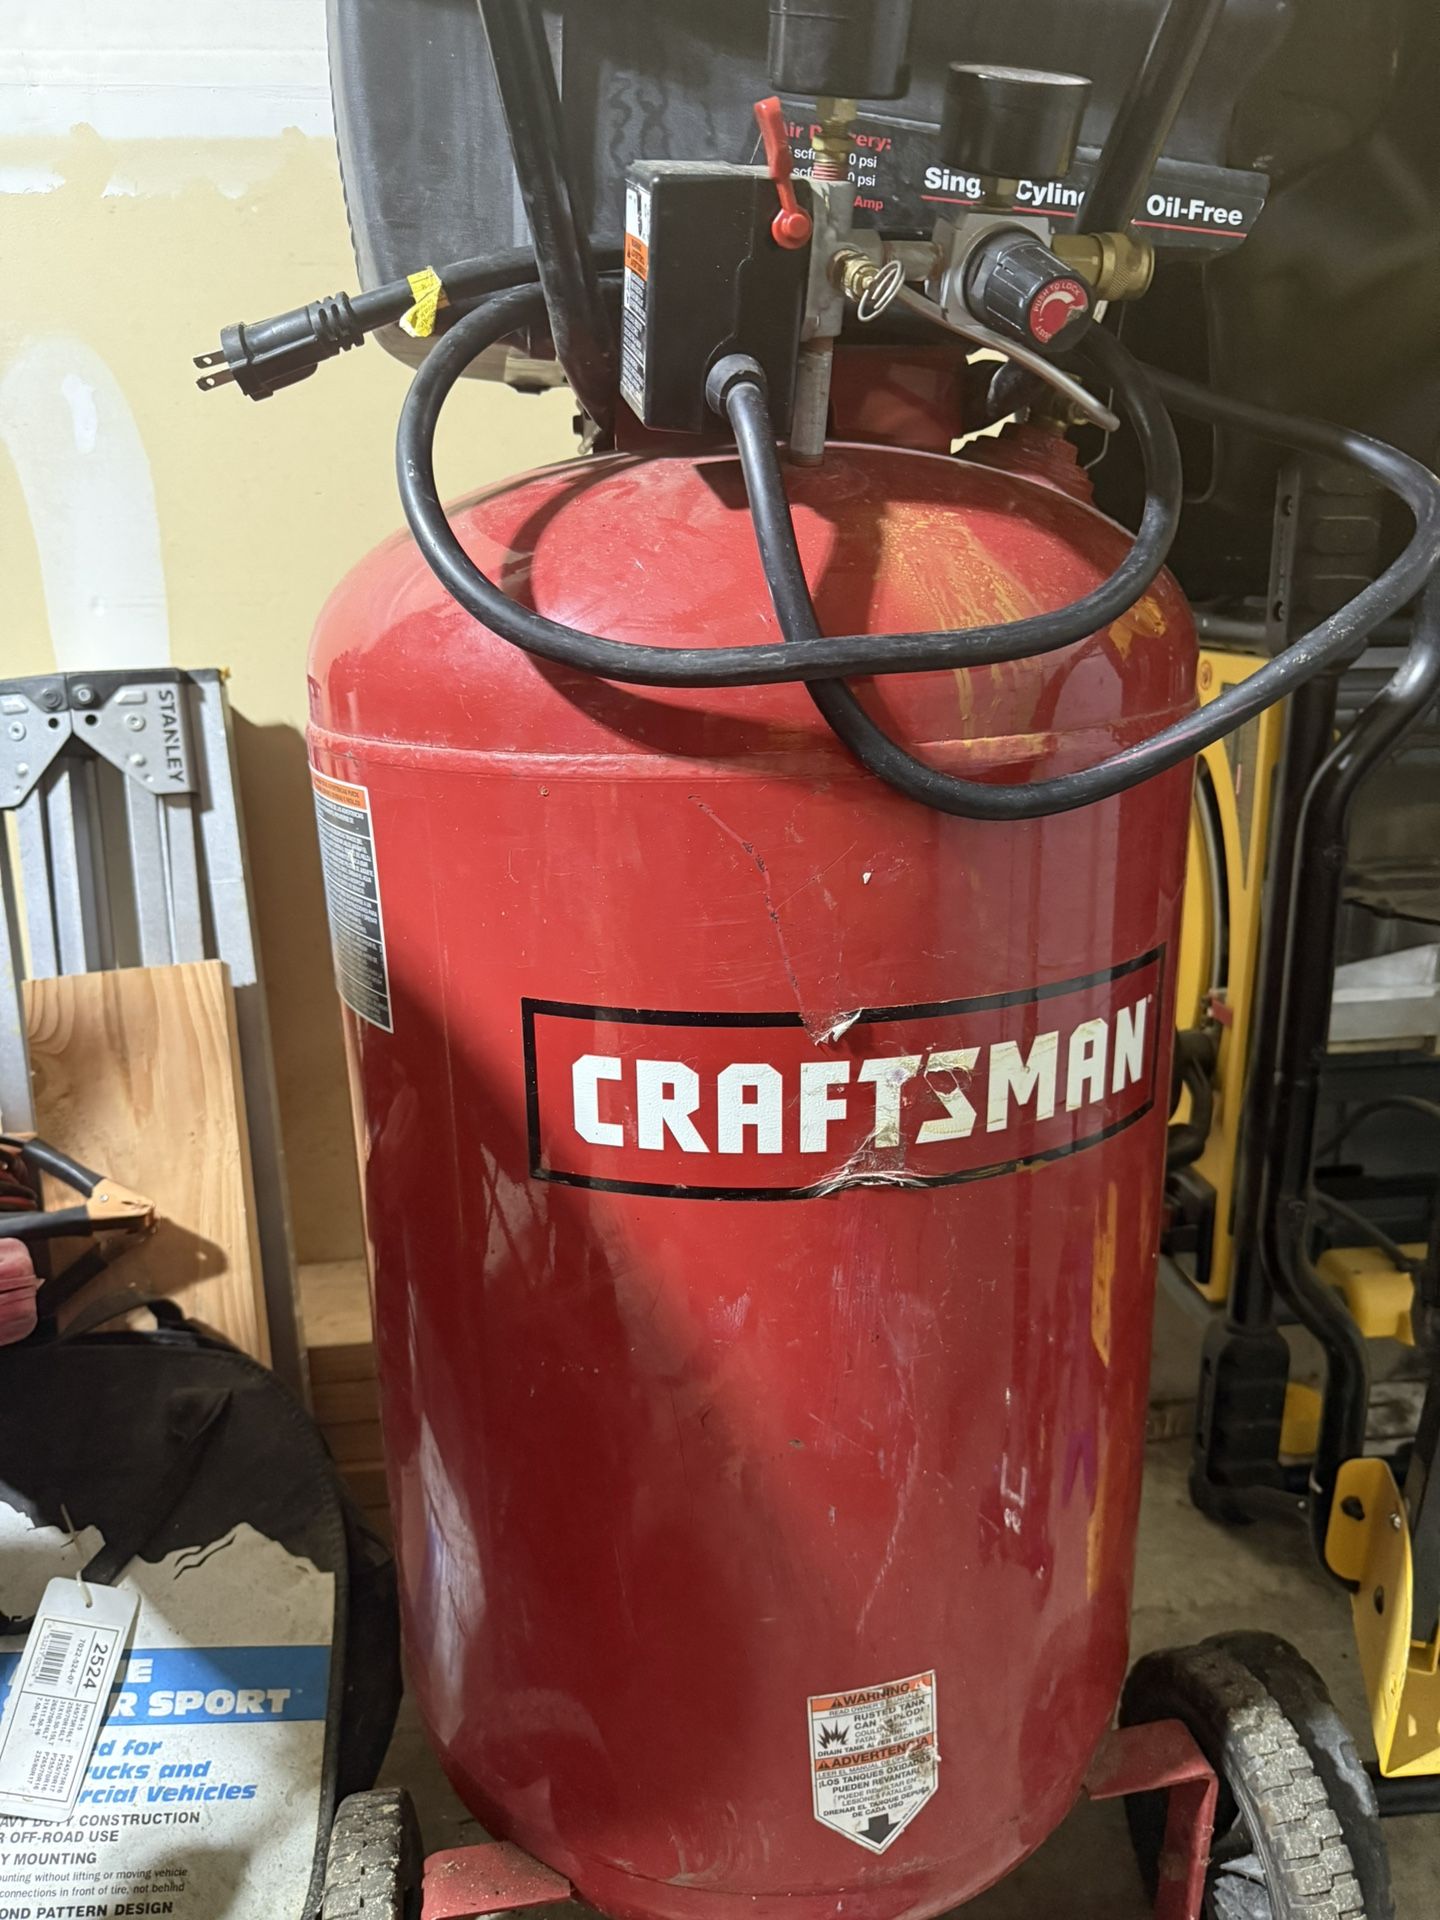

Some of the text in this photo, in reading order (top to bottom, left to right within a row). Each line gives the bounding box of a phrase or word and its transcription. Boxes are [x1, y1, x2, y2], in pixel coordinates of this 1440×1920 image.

[859, 156, 877, 169] psi
[857, 175, 876, 187] psi
[854, 195, 884, 212] Amp
[1146, 193, 1244, 227] Oil-Free
[1032, 281, 1081, 312] PUSH TO LOCK
[158, 690, 185, 783] STANLEY
[571, 996, 1150, 1155] CRAFTSMAN
[82, 1642, 109, 1689] 2524
[148, 1688, 291, 1717] SPORT
[843, 1682, 910, 1707] WARNING
[829, 1707, 849, 1717] READ
[854, 1706, 897, 1722] RUSTED
[854, 1719, 877, 1731] CAN
[122, 1739, 163, 1756] for
[818, 1749, 842, 1758] DRAIN
[845, 1745, 865, 1755] TANK
[893, 1733, 915, 1742] EACH
[916, 1726, 930, 1736] USE
[831, 1736, 929, 1768] ADVERTENCIA
[88, 1760, 212, 1780] ucks and
[818, 1770, 838, 1778] LEER
[839, 1768, 847, 1776] EL
[849, 1763, 879, 1774] MANUAL
[842, 1769, 884, 1784] TANQUES
[886, 1755, 931, 1774] OXIDADOS
[832, 1782, 870, 1793] PUEDEN
[906, 1777, 917, 1786] EN
[147, 1783, 258, 1803] Vehicles
[842, 1785, 913, 1807] LESIONES FATALES
[823, 1805, 856, 1817] DRENAR
[869, 1796, 900, 1808] TANQUE
[852, 1801, 904, 1818] DE CADA USO
[79, 1811, 200, 1827] CONSTRUCTION
[10, 1831, 85, 1844] OFF-ROAD
[89, 1830, 120, 1843] USE
[13, 1852, 98, 1866] MOUNTING
[34, 1871, 70, 1882] without
[72, 1870, 101, 1883] lifting
[103, 1871, 114, 1880] or
[116, 1869, 152, 1881] moving
[153, 1867, 188, 1878] vehicle
[0, 1887, 57, 1899] connections
[59, 1886, 69, 1897] in
[71, 1885, 96, 1896] front
[99, 1885, 108, 1896] of
[133, 1883, 149, 1893] not
[152, 1881, 186, 1893] behind
[36, 1904, 108, 1919] PATTERN
[114, 1901, 174, 1916] DESIGN
